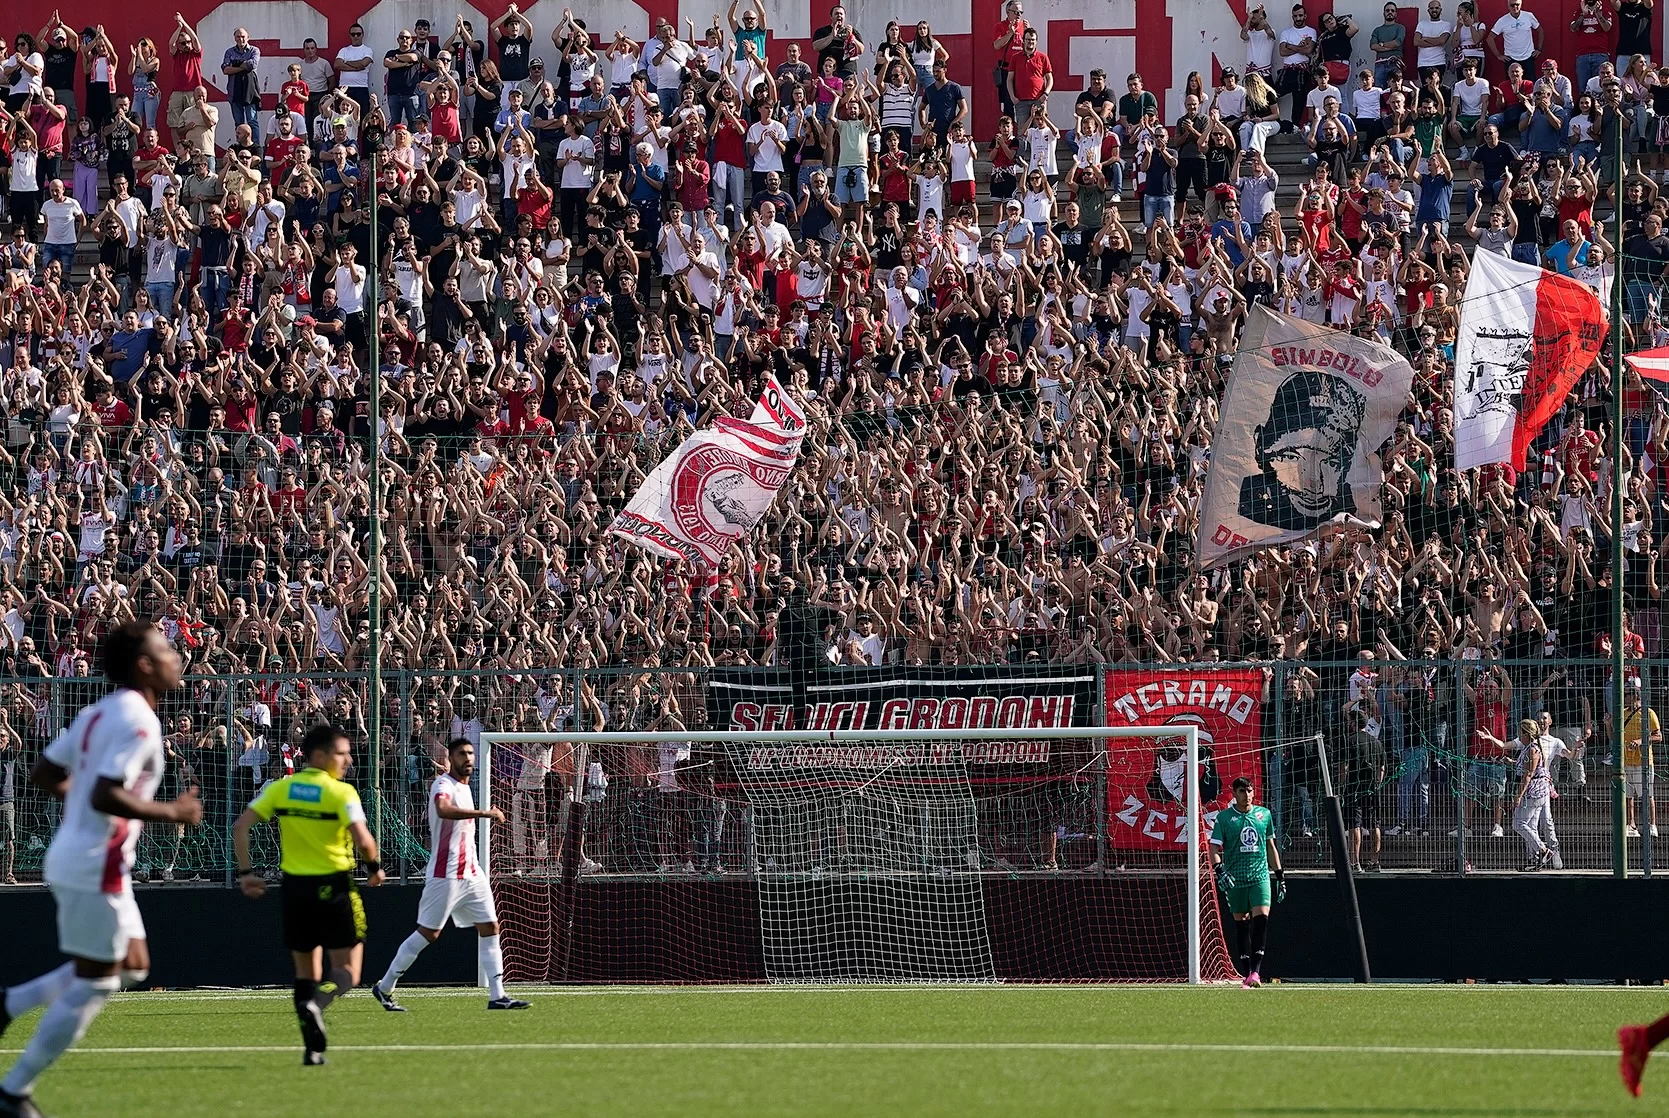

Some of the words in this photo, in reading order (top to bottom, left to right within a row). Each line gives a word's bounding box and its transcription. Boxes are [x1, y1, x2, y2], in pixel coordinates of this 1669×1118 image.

[882, 233, 897, 252] NY
[1271, 346, 1385, 388] SIMBOLO
[880, 695, 1075, 730] GRADONI
[1113, 679, 1255, 725] TERAMO
[962, 741, 1051, 764] PADRONI
